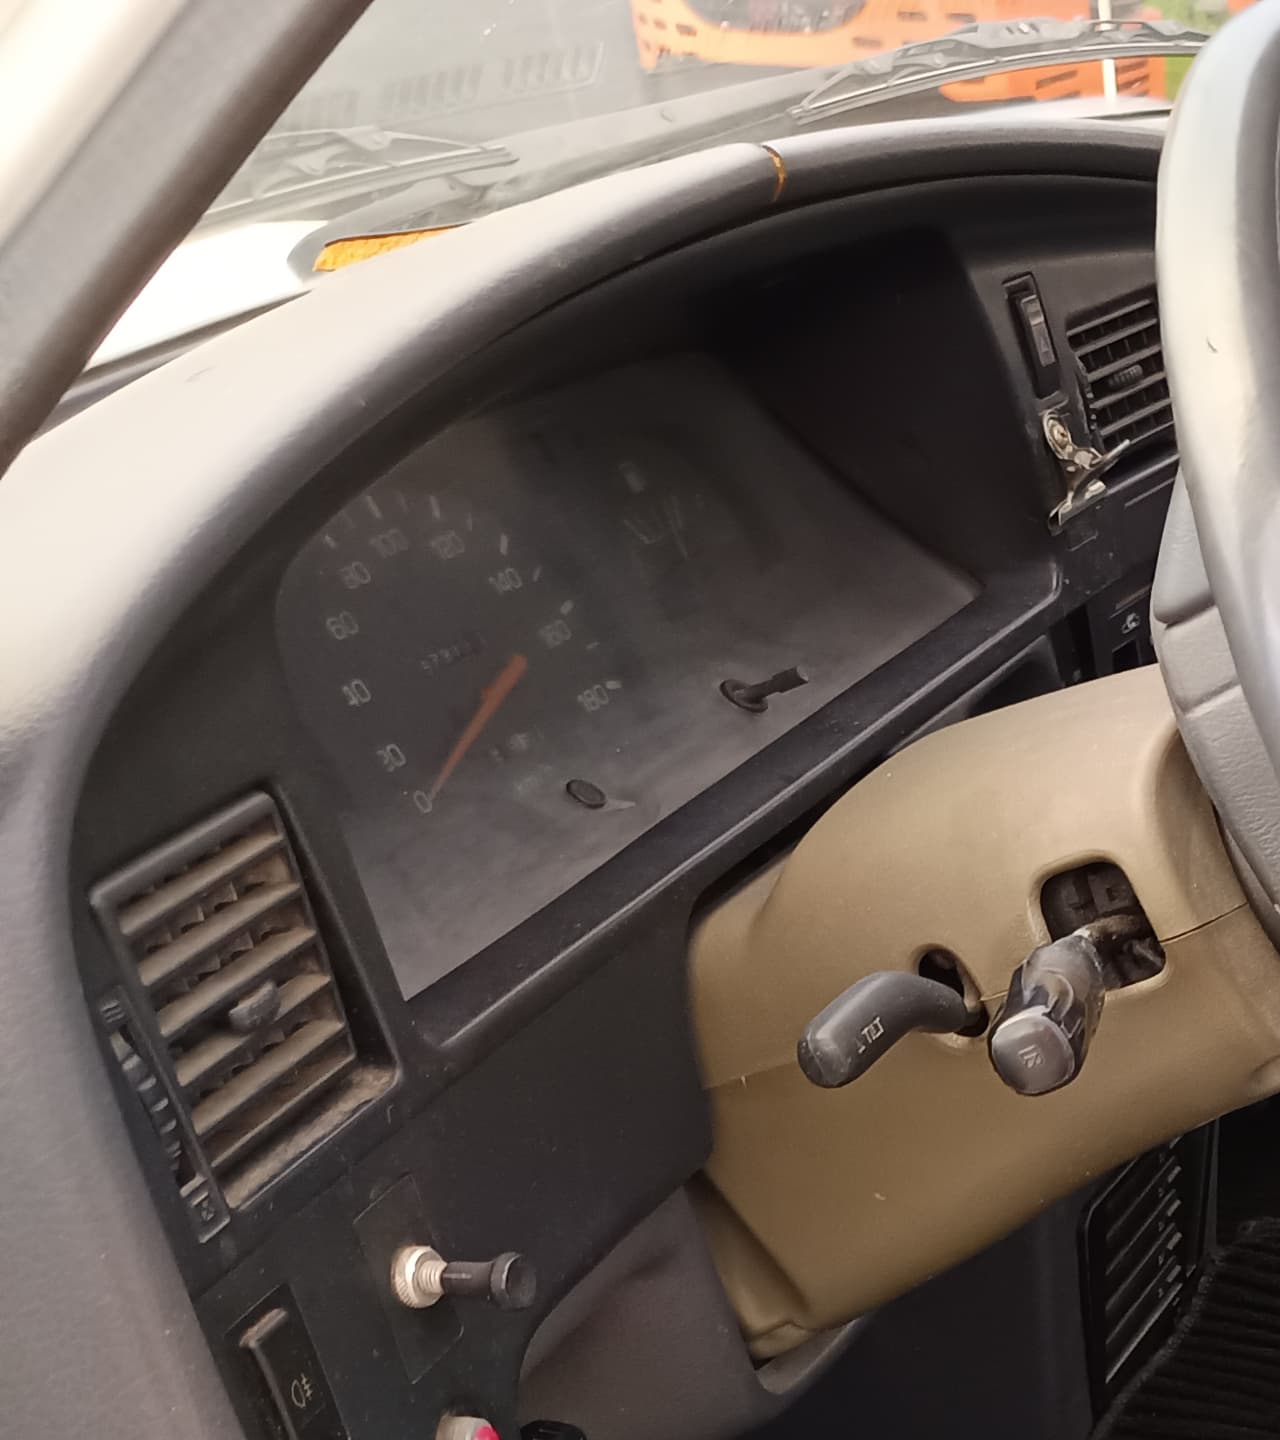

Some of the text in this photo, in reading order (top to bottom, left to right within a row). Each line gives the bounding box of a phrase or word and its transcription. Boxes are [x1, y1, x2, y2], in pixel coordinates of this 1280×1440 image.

[325, 610, 360, 641] 60
[340, 678, 372, 707] 40
[576, 683, 610, 713] 180
[412, 789, 433, 815] 0
